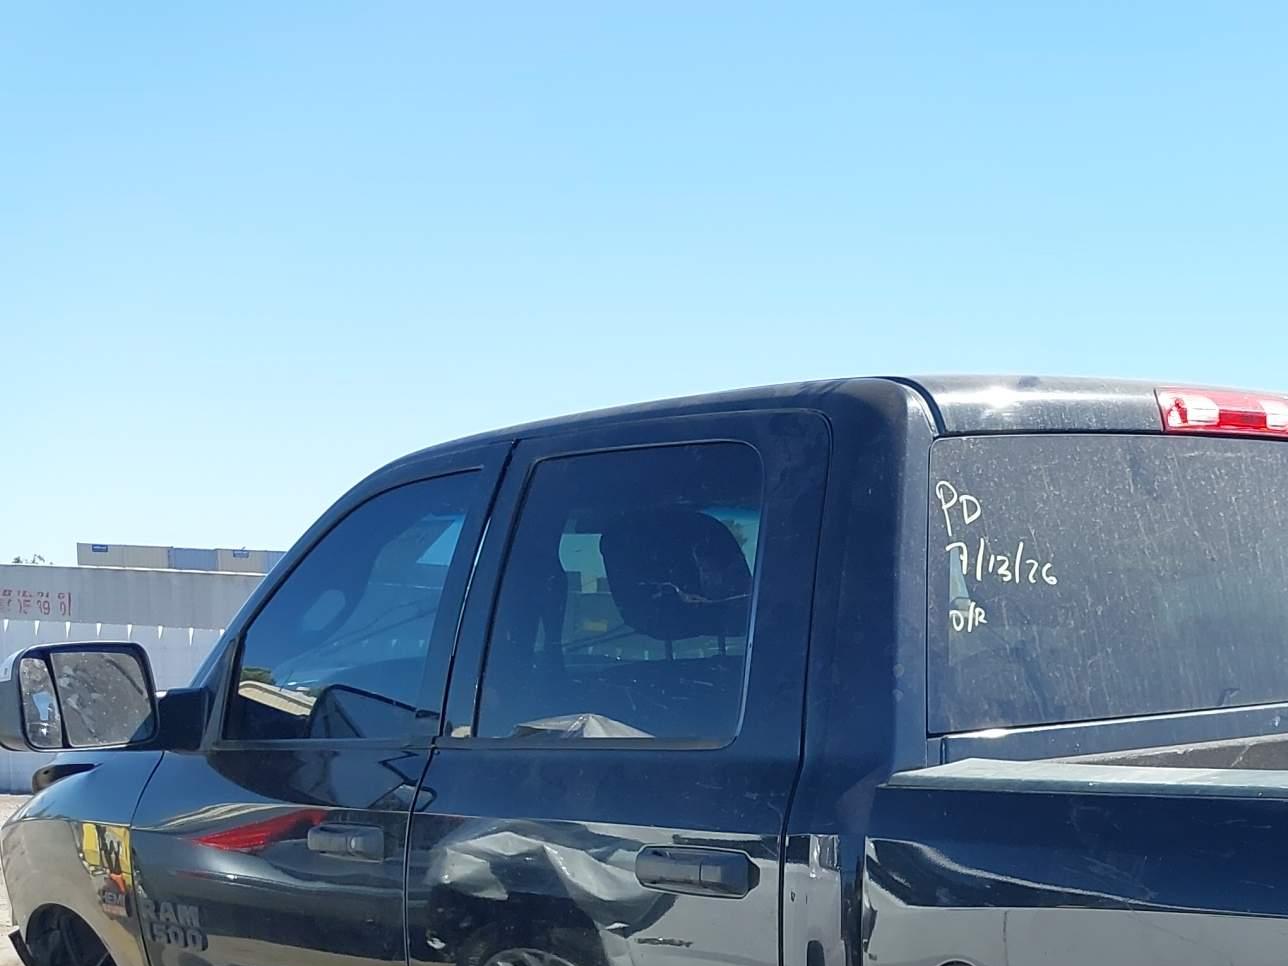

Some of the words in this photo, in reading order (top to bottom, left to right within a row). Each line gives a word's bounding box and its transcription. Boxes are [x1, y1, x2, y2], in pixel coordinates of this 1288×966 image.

[936, 481, 981, 536] PD
[946, 537, 1058, 585] 7/13/26
[139, 897, 200, 928] RAM
[142, 918, 205, 951] 1500
